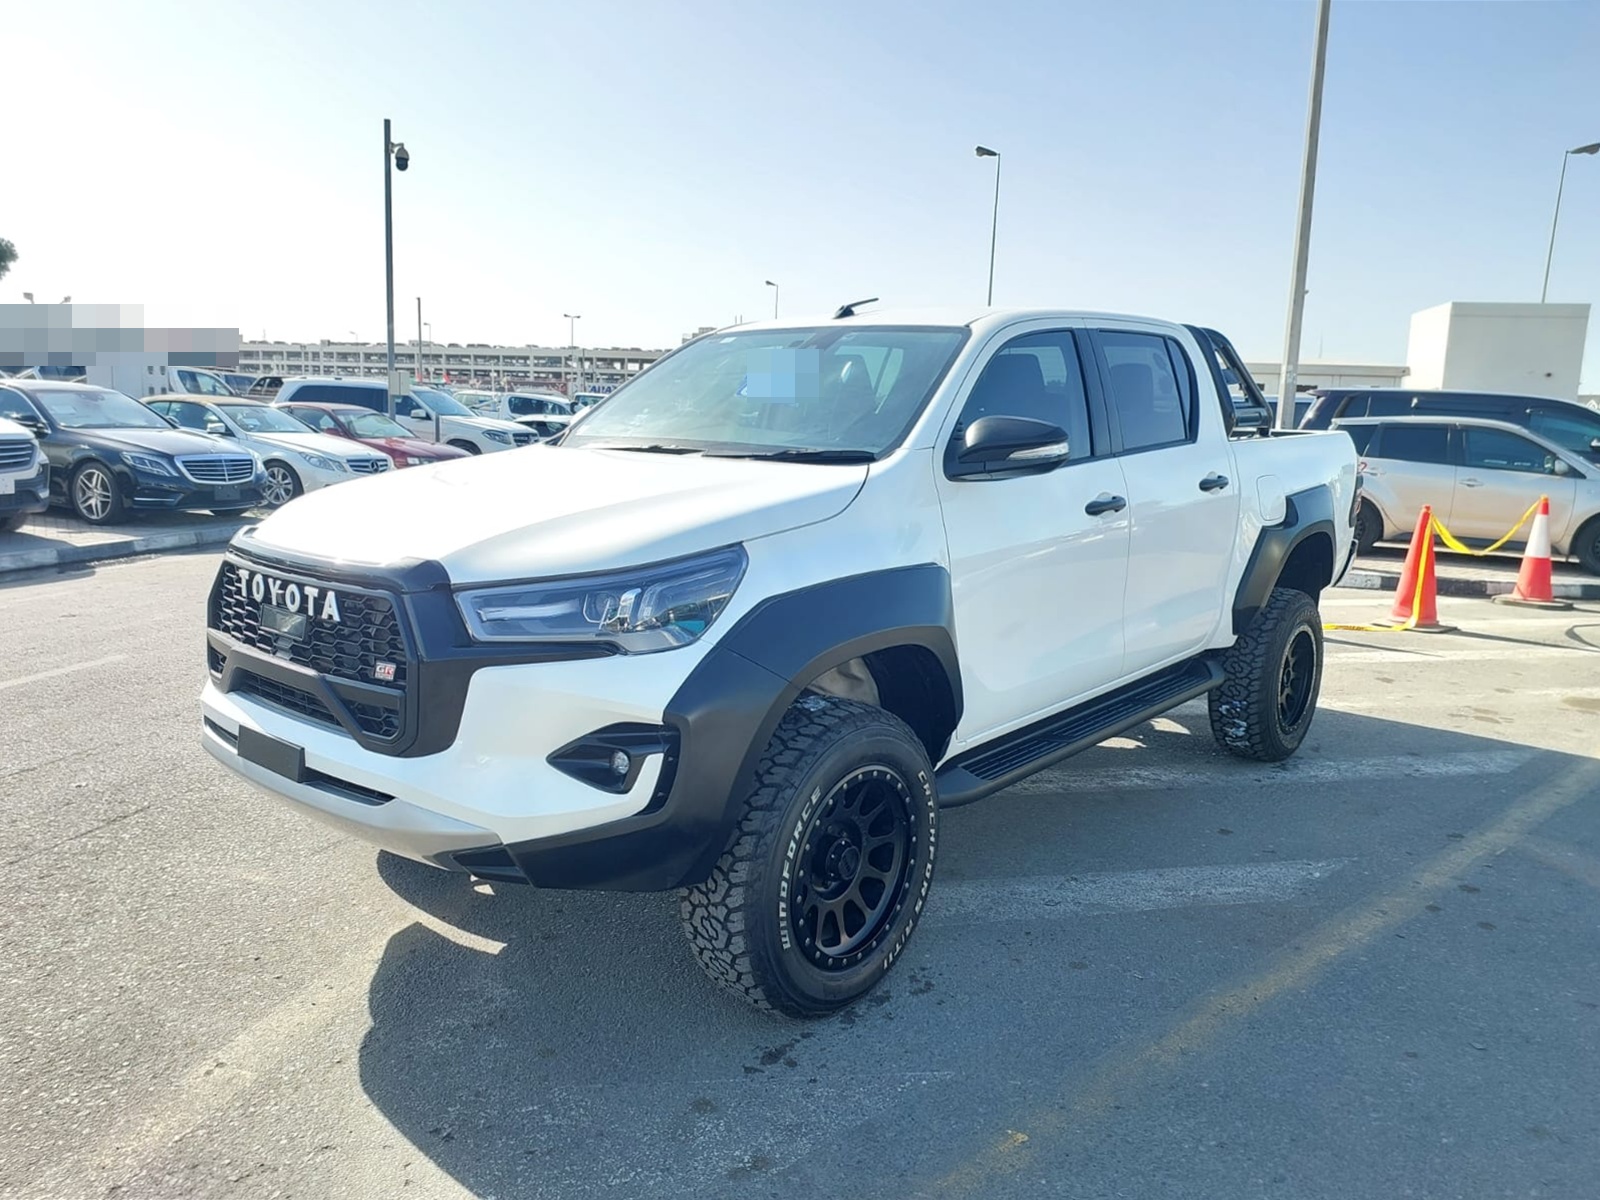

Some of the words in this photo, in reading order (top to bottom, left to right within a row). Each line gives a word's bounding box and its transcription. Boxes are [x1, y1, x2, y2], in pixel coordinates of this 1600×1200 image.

[238, 569, 340, 622] TOYOTA
[779, 786, 822, 950] WINDFORCE
[915, 770, 936, 914] CATCHFORS
